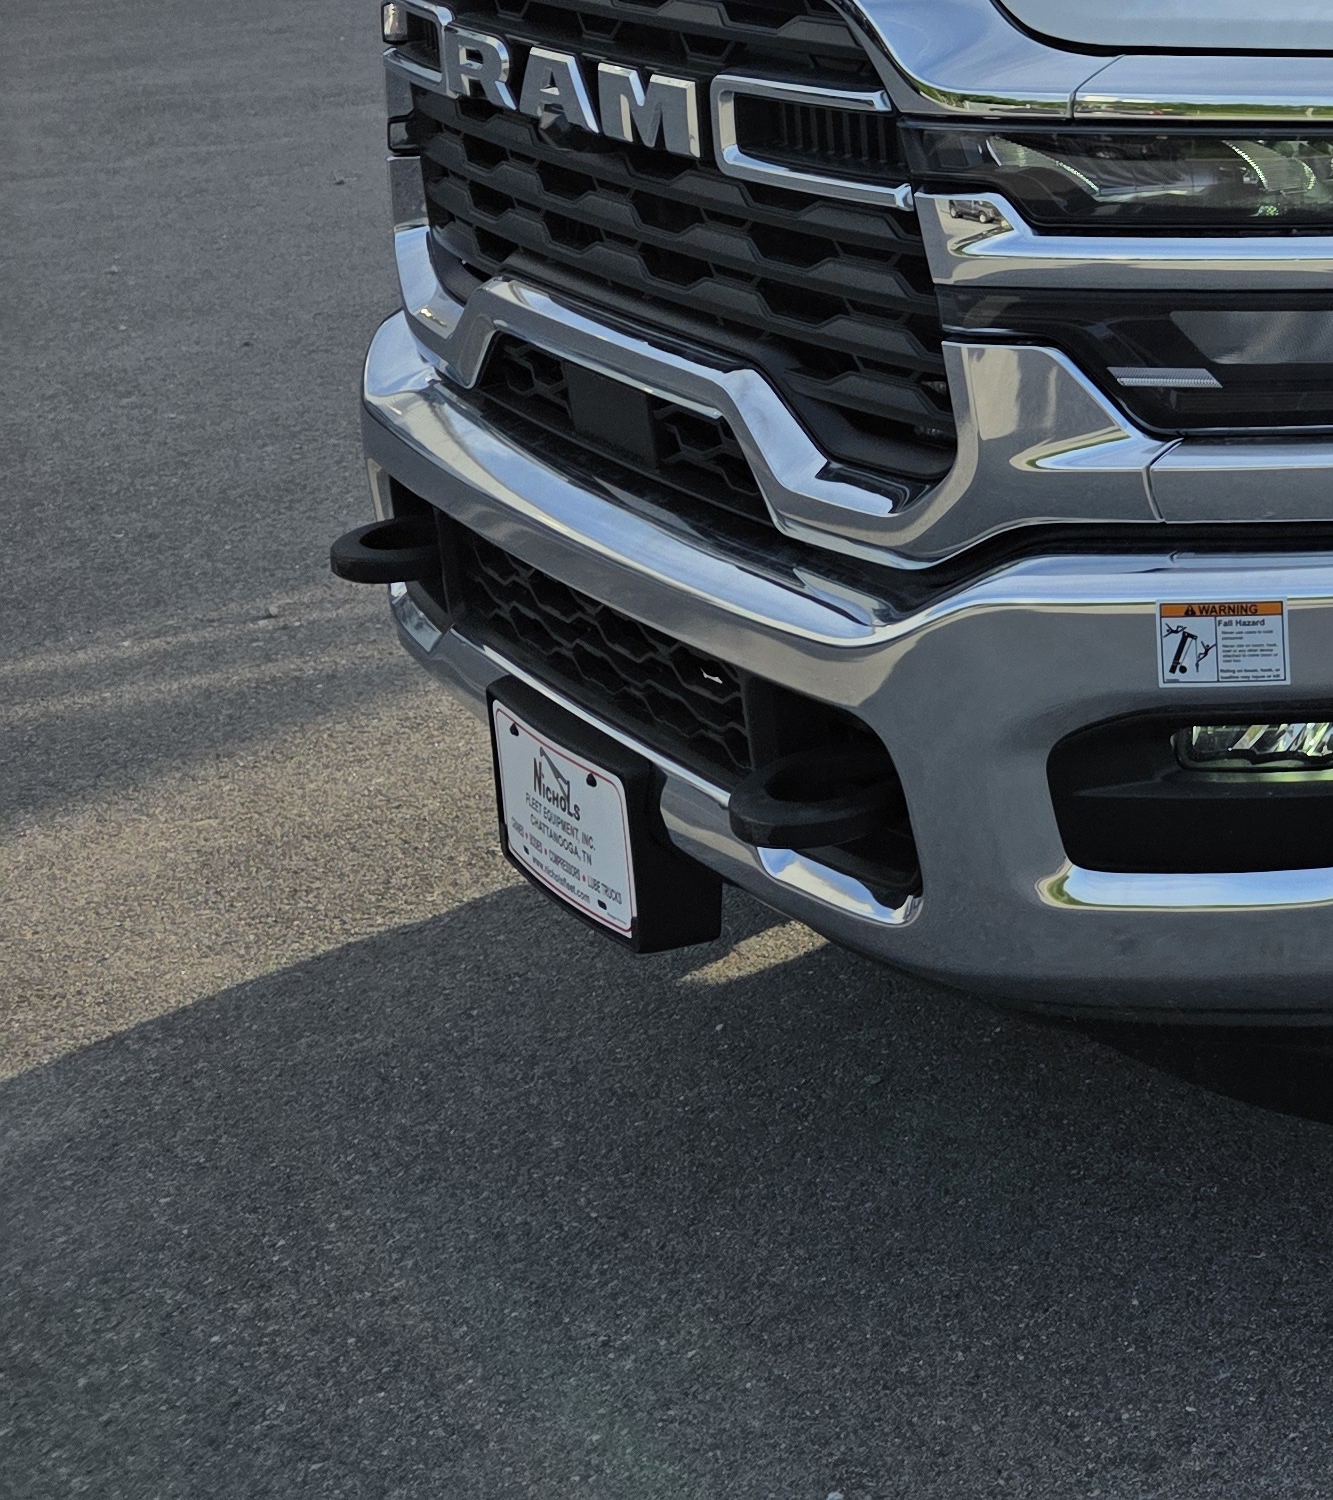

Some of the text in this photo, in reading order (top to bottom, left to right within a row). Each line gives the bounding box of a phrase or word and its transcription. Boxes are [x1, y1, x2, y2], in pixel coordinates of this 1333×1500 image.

[441, 24, 700, 158] RAM
[1198, 604, 1258, 616] WARNING
[1217, 619, 1265, 627] Fall Hazard
[526, 792, 596, 851] FLEET EQUIPMENT, INC.
[530, 813, 592, 866] CHATTANOOGA, TN
